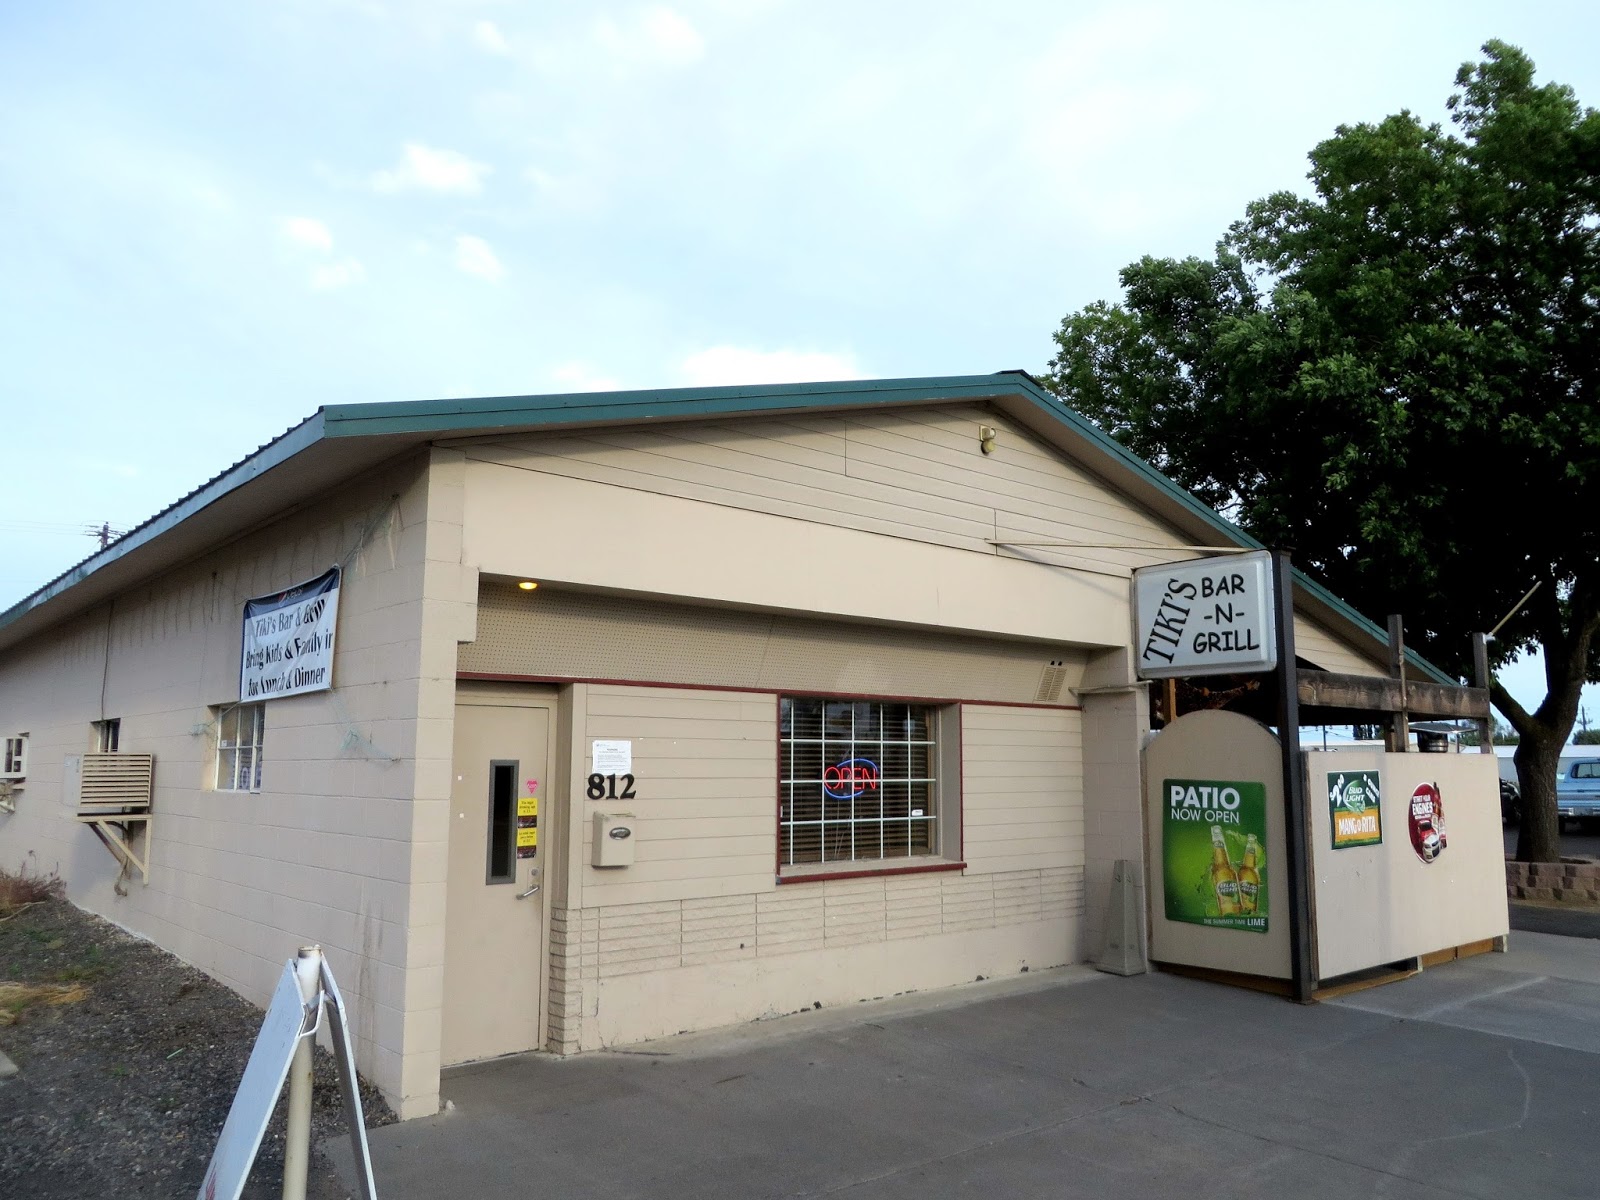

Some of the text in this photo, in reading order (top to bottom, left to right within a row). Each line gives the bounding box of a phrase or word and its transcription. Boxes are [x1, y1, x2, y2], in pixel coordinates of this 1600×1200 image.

[1201, 574, 1245, 598] BAR
[256, 616, 276, 638] Tiki's
[278, 612, 294, 632] Bar
[1142, 578, 1198, 664] TIKI'S
[246, 650, 264, 670] Bring
[266, 643, 282, 664] Kids
[284, 640, 294, 660] &
[294, 632, 324, 656] Family
[1193, 628, 1260, 654] GRILL
[248, 666, 326, 696] for Lunch & Dinner
[586, 773, 636, 800] 812
[824, 766, 878, 790] OPEN
[1170, 785, 1240, 810] PATIO
[1412, 802, 1433, 815] ENGINES
[1171, 808, 1240, 824] NOW OPEN
